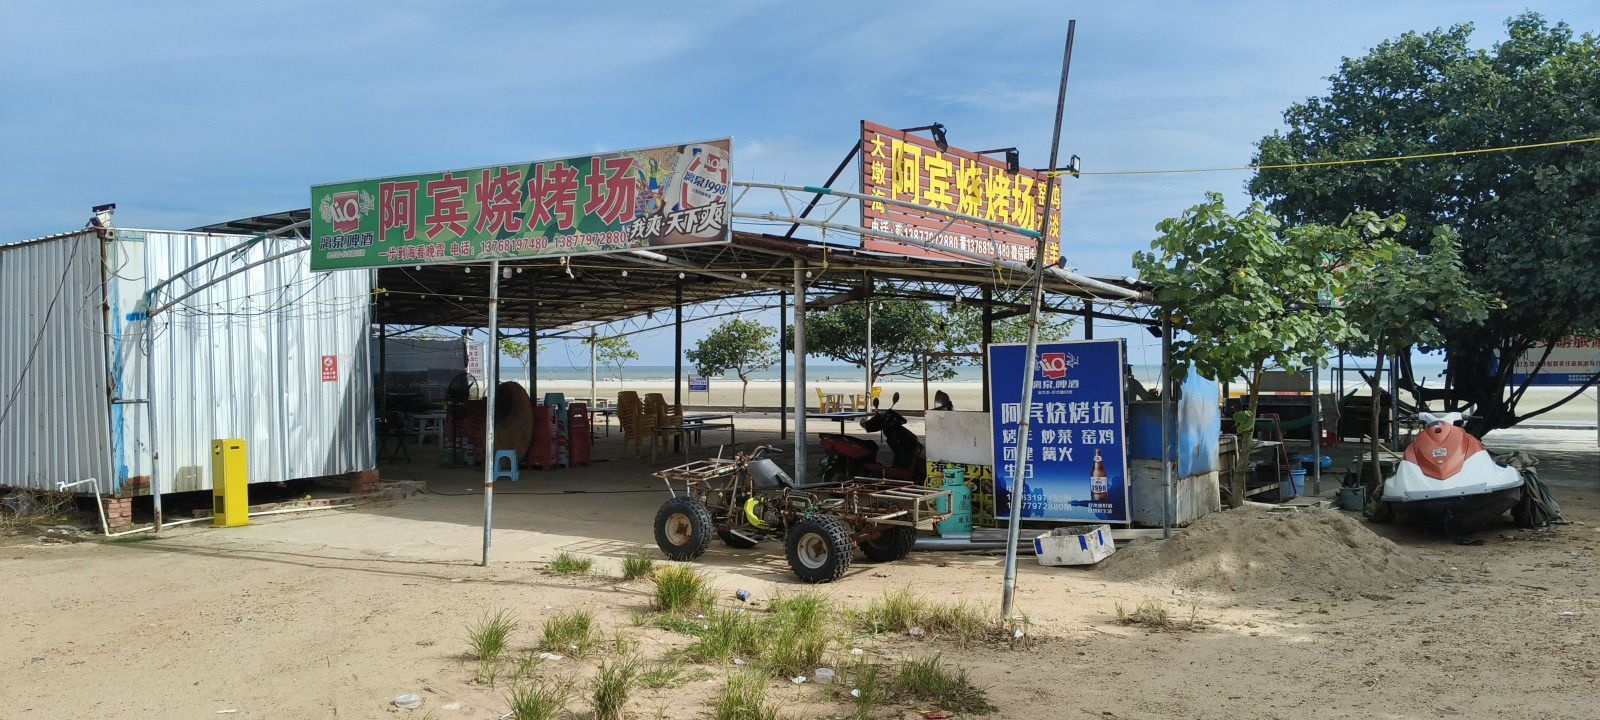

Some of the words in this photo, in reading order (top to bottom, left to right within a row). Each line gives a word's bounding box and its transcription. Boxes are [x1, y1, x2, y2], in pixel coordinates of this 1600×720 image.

[891, 138, 1036, 232] 阿宾烧烤场
[378, 156, 637, 243] 阿宾烧烤场
[378, 243, 446, 262] 一步到海看晚霞
[480, 237, 549, 253] 13768197480
[554, 231, 628, 249] 13877972880
[1041, 429, 1073, 444] 炒菜
[1081, 429, 1115, 445] 窑鸡
[1042, 446, 1073, 462] 篝火
[1004, 464, 1034, 479] 生日
